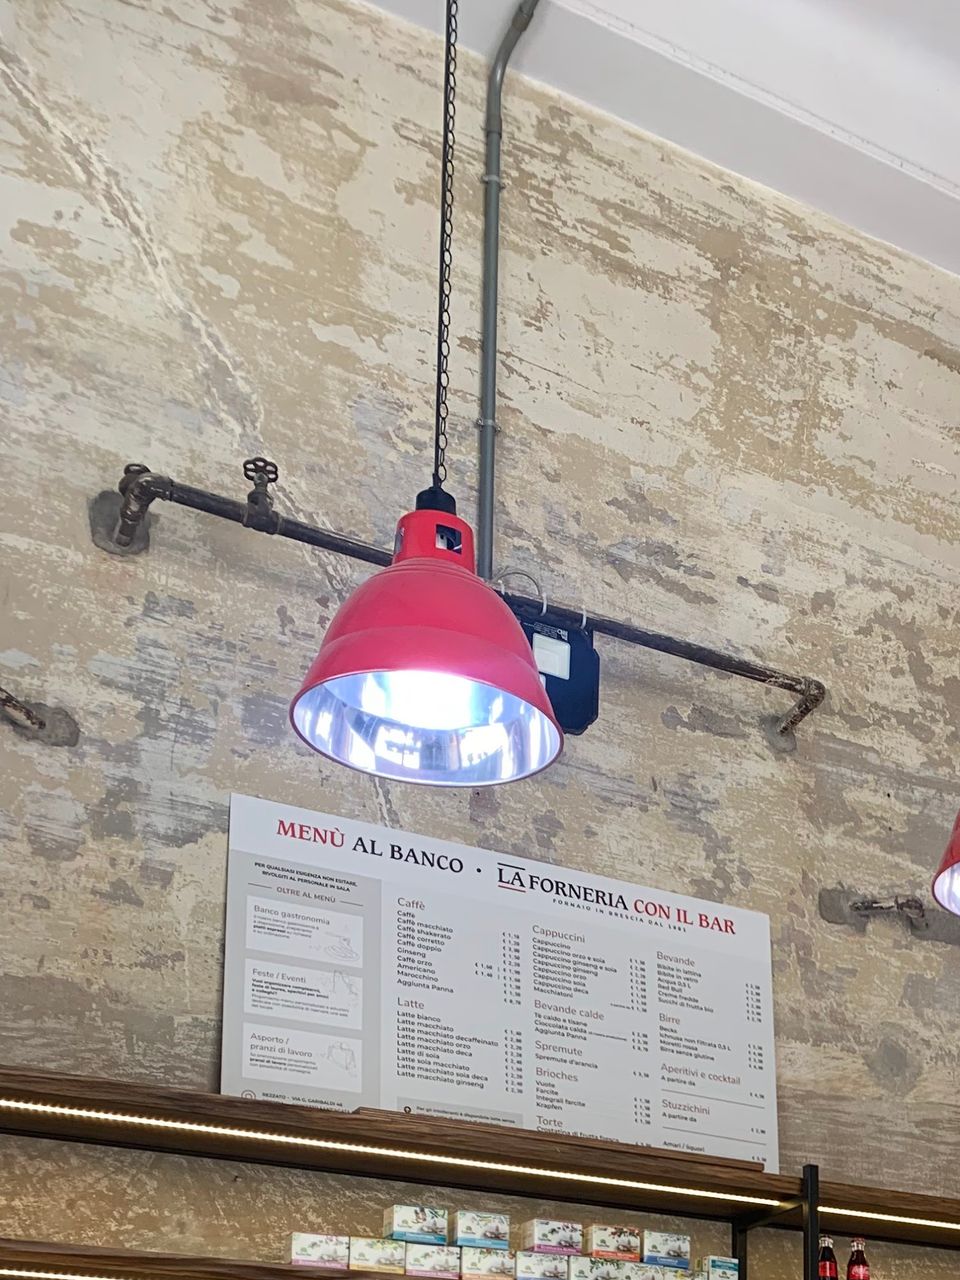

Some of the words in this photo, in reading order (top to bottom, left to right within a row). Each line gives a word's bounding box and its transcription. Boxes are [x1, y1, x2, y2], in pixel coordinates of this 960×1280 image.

[276, 818, 345, 848] MENÙ
[352, 836, 384, 856] AL
[390, 846, 464, 873] BANCO
[498, 866, 525, 888] LA
[529, 875, 628, 911] FORNERIA
[634, 899, 671, 920] CON
[676, 908, 694, 925] IL
[699, 913, 736, 935] BAR
[276, 886, 300, 896] OLTRE
[314, 893, 335, 903] MENÙ
[397, 896, 424, 911] Caffè
[553, 898, 591, 911] FORNAIO
[596, 906, 605, 914] IN
[608, 910, 644, 923] BRESCIA
[254, 904, 278, 915] Banco
[281, 910, 329, 926] gastronomia
[397, 910, 415, 919] Caffè
[397, 917, 415, 926] Caffè
[417, 921, 453, 933] macchiato
[397, 924, 415, 933] Caffè
[417, 928, 451, 940] shakerato
[397, 931, 415, 940] Caffè
[416, 935, 444, 946] corretto
[532, 924, 584, 944] Cappuccini
[396, 938, 415, 948] Caffè
[416, 942, 441, 953] doppio
[532, 937, 570, 950] Cappuccino
[397, 947, 426, 958] Ginseng
[656, 951, 695, 967] Bevande
[396, 955, 415, 963] Caffè
[416, 958, 432, 967] orzo
[397, 962, 435, 974] Americano
[252, 968, 274, 978] Feste
[281, 973, 306, 984] Eventi
[397, 969, 438, 982] Marocchino
[397, 978, 429, 990] Aggiunta
[431, 984, 453, 995] Panna
[397, 996, 424, 1010] Latte
[534, 999, 576, 1015] Bevande
[579, 1007, 604, 1020] calde
[397, 1010, 415, 1018] Latte
[417, 1013, 440, 1023] bianco
[659, 1012, 680, 1025] Birre
[397, 1018, 415, 1026] Latte
[417, 1021, 453, 1032] macchiato
[534, 1019, 565, 1030] Cioccolata
[566, 1025, 587, 1034] calda
[250, 1032, 283, 1044] Asporto
[285, 1037, 289, 1045] /
[397, 1025, 415, 1033] Latte
[417, 1028, 454, 1039] macchiato
[455, 1035, 498, 1047] decaffeinato
[397, 1032, 414, 1040] Latte
[417, 1035, 454, 1047] macchiato
[534, 1026, 565, 1037] Aggiunta
[566, 1032, 586, 1041] Panna
[250, 1042, 275, 1053] pranzi
[277, 1046, 285, 1054] di
[287, 1048, 312, 1058] lavoro
[397, 1040, 414, 1048] Latte
[417, 1043, 453, 1054] macchiato
[455, 1049, 472, 1057] deca
[397, 1047, 415, 1055] Latte
[534, 1039, 582, 1057] Spremute
[397, 1054, 415, 1063] Latte
[433, 1060, 469, 1071] macchiato
[396, 1069, 415, 1078] Latte
[417, 1072, 454, 1084] macchiato
[456, 1079, 484, 1089] ginseng
[397, 1062, 415, 1070] Latte
[417, 1065, 453, 1076] macchiato
[455, 1071, 469, 1079] soia
[471, 1074, 488, 1082] deca
[535, 1066, 578, 1082] Brioches
[660, 1063, 698, 1077] Aperitivi
[700, 1069, 705, 1079] e
[708, 1071, 740, 1085] cocktail
[662, 1098, 710, 1115] Stuzzichini
[536, 1114, 563, 1128] Torte
